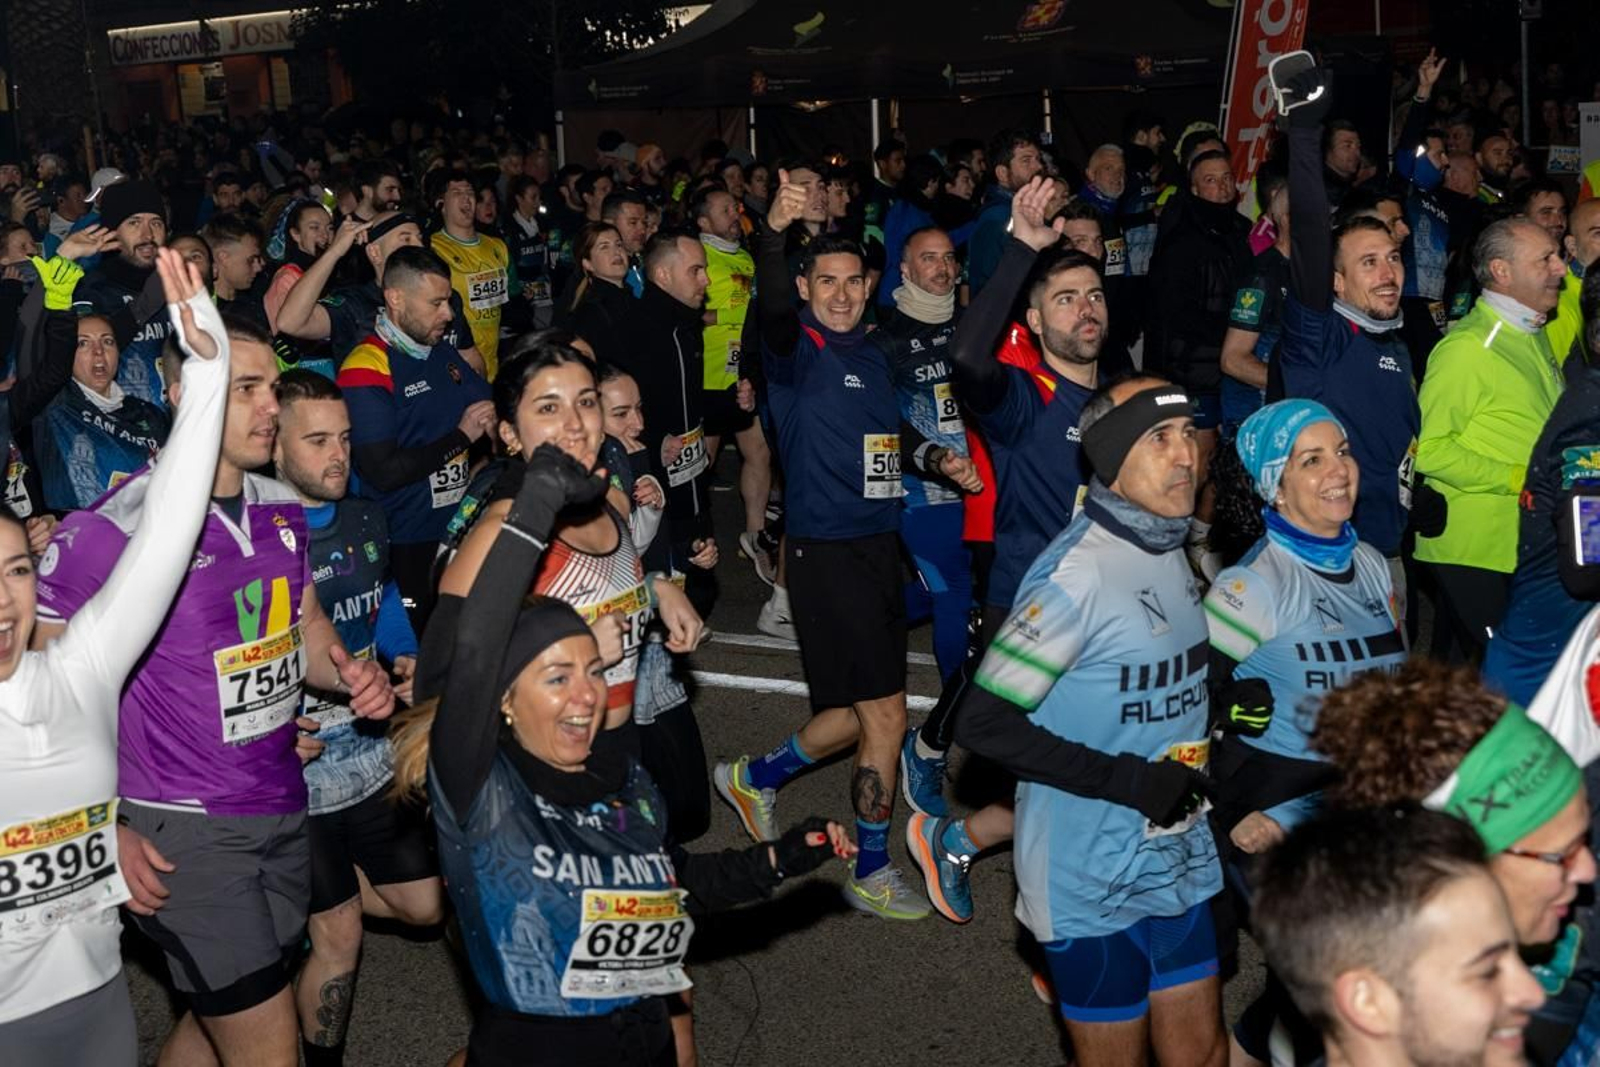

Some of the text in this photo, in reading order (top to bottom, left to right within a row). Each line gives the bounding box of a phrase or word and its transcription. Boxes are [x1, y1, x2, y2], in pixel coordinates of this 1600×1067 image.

[473, 279, 504, 297] 5481
[914, 361, 946, 382] SAN
[229, 651, 300, 703] 7541
[4, 826, 34, 848] 42
[0, 832, 106, 898] 8396
[532, 844, 604, 887] SAN
[614, 897, 638, 916] 42
[587, 921, 685, 957] 6828
